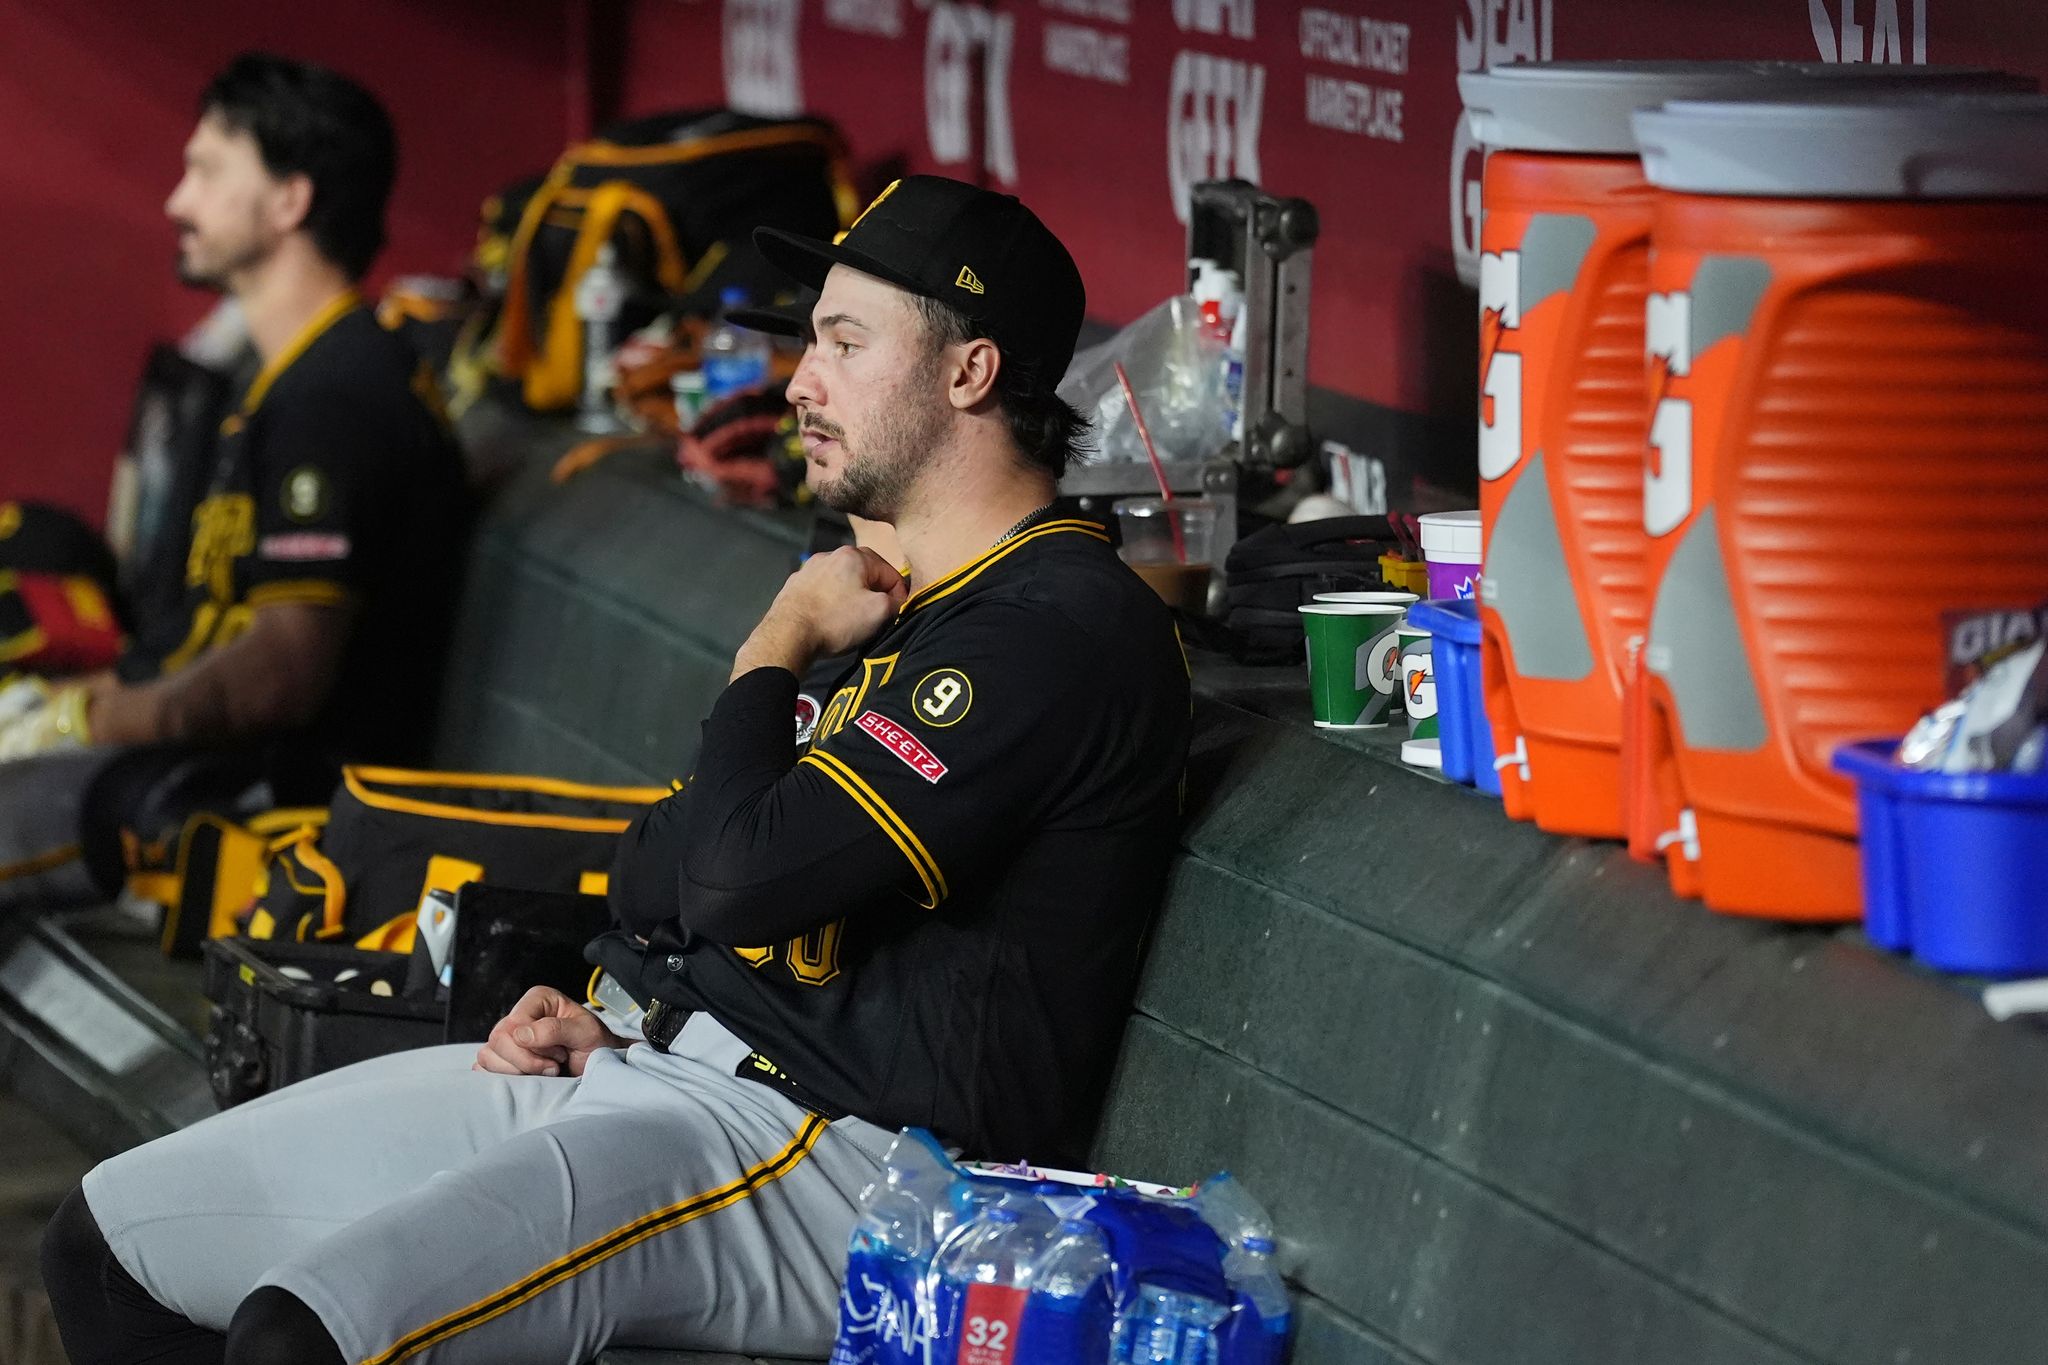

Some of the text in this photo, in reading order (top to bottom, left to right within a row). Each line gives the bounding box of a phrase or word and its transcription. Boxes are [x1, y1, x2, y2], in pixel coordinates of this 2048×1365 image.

[922, 677, 962, 718] 9
[861, 714, 938, 776] SHEETZ
[966, 1315, 1009, 1351] 32
